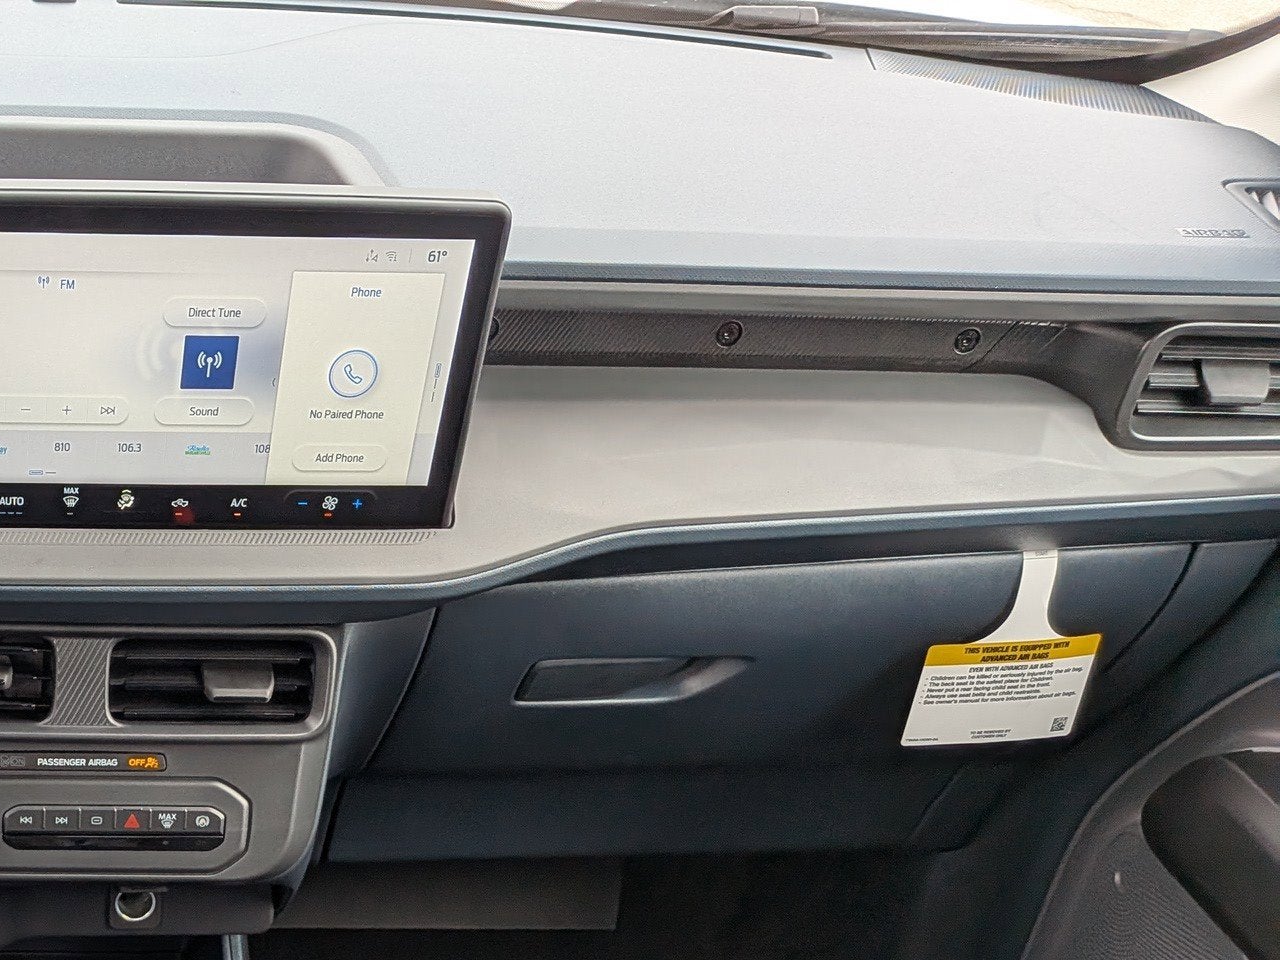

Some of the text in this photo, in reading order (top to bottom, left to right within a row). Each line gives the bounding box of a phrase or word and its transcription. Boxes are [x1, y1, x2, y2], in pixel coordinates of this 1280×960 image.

[1180, 229, 1249, 238] AIRBAG
[428, 250, 447, 263] 61°
[60, 279, 76, 290] FM
[351, 287, 382, 299] Phone
[188, 307, 241, 319] Direct Tune
[189, 406, 219, 418] Sound
[309, 409, 384, 421] No Paired Phone
[54, 442, 71, 453] 810
[117, 443, 142, 454] 106.3
[254, 443, 270, 454] 108
[315, 453, 364, 465] Add Phone
[64, 487, 80, 495] MAX
[0, 496, 24, 507] AUTO
[230, 498, 248, 508] A/C
[1020, 643, 1052, 652] EQUIPPED
[37, 757, 118, 768] PASSENGER AIRBAG
[128, 758, 146, 768] OFF
[158, 813, 178, 821] MAX
